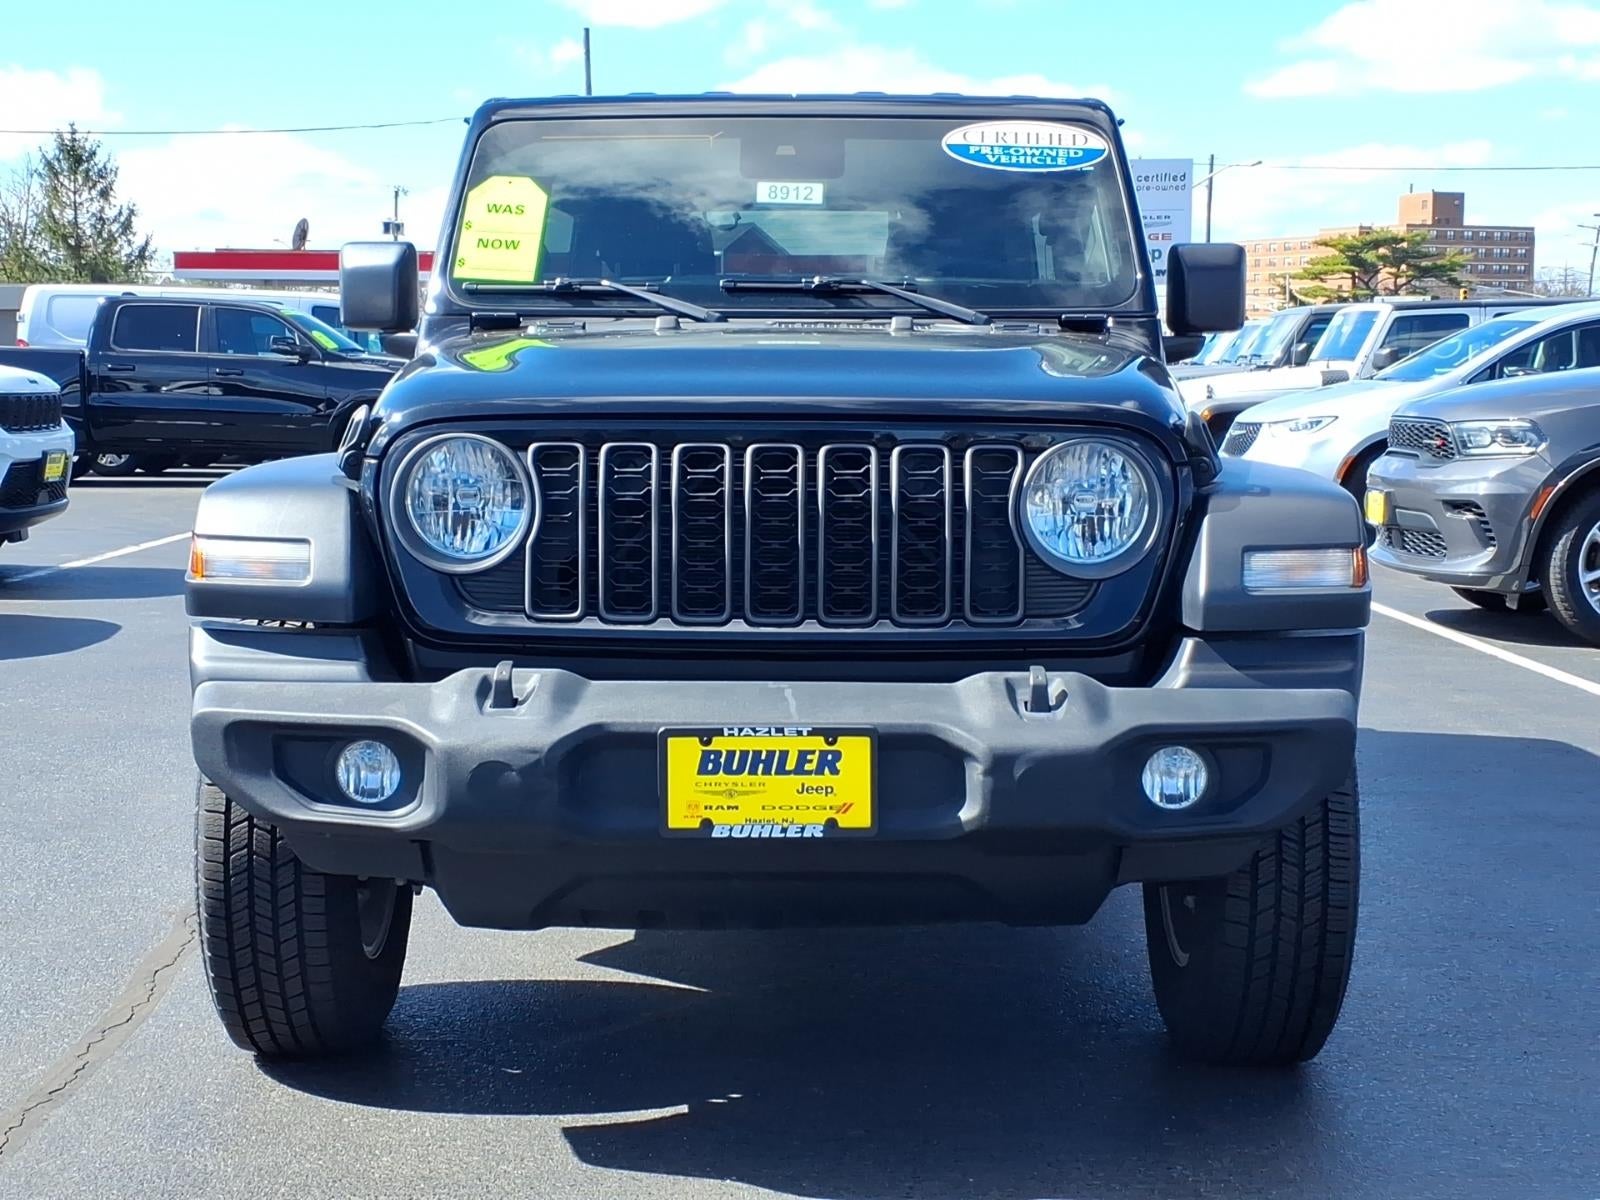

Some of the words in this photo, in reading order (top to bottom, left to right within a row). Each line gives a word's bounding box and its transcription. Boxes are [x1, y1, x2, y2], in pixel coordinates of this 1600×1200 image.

[963, 131, 1088, 146] CERTIFIED
[969, 145, 1084, 158] PRE-OWNED
[985, 155, 1068, 165] VEHICLE
[1136, 172, 1186, 182] certified
[768, 184, 814, 201] 8912
[487, 203, 526, 216] WAS
[464, 220, 473, 231] $
[477, 237, 521, 250] NOW
[457, 257, 466, 268] $
[723, 727, 813, 737] HAZLET
[696, 749, 842, 776] BUHLER
[796, 782, 835, 797] Jeep
[781, 816, 795, 824] NJ
[710, 824, 824, 838] BUHLER
